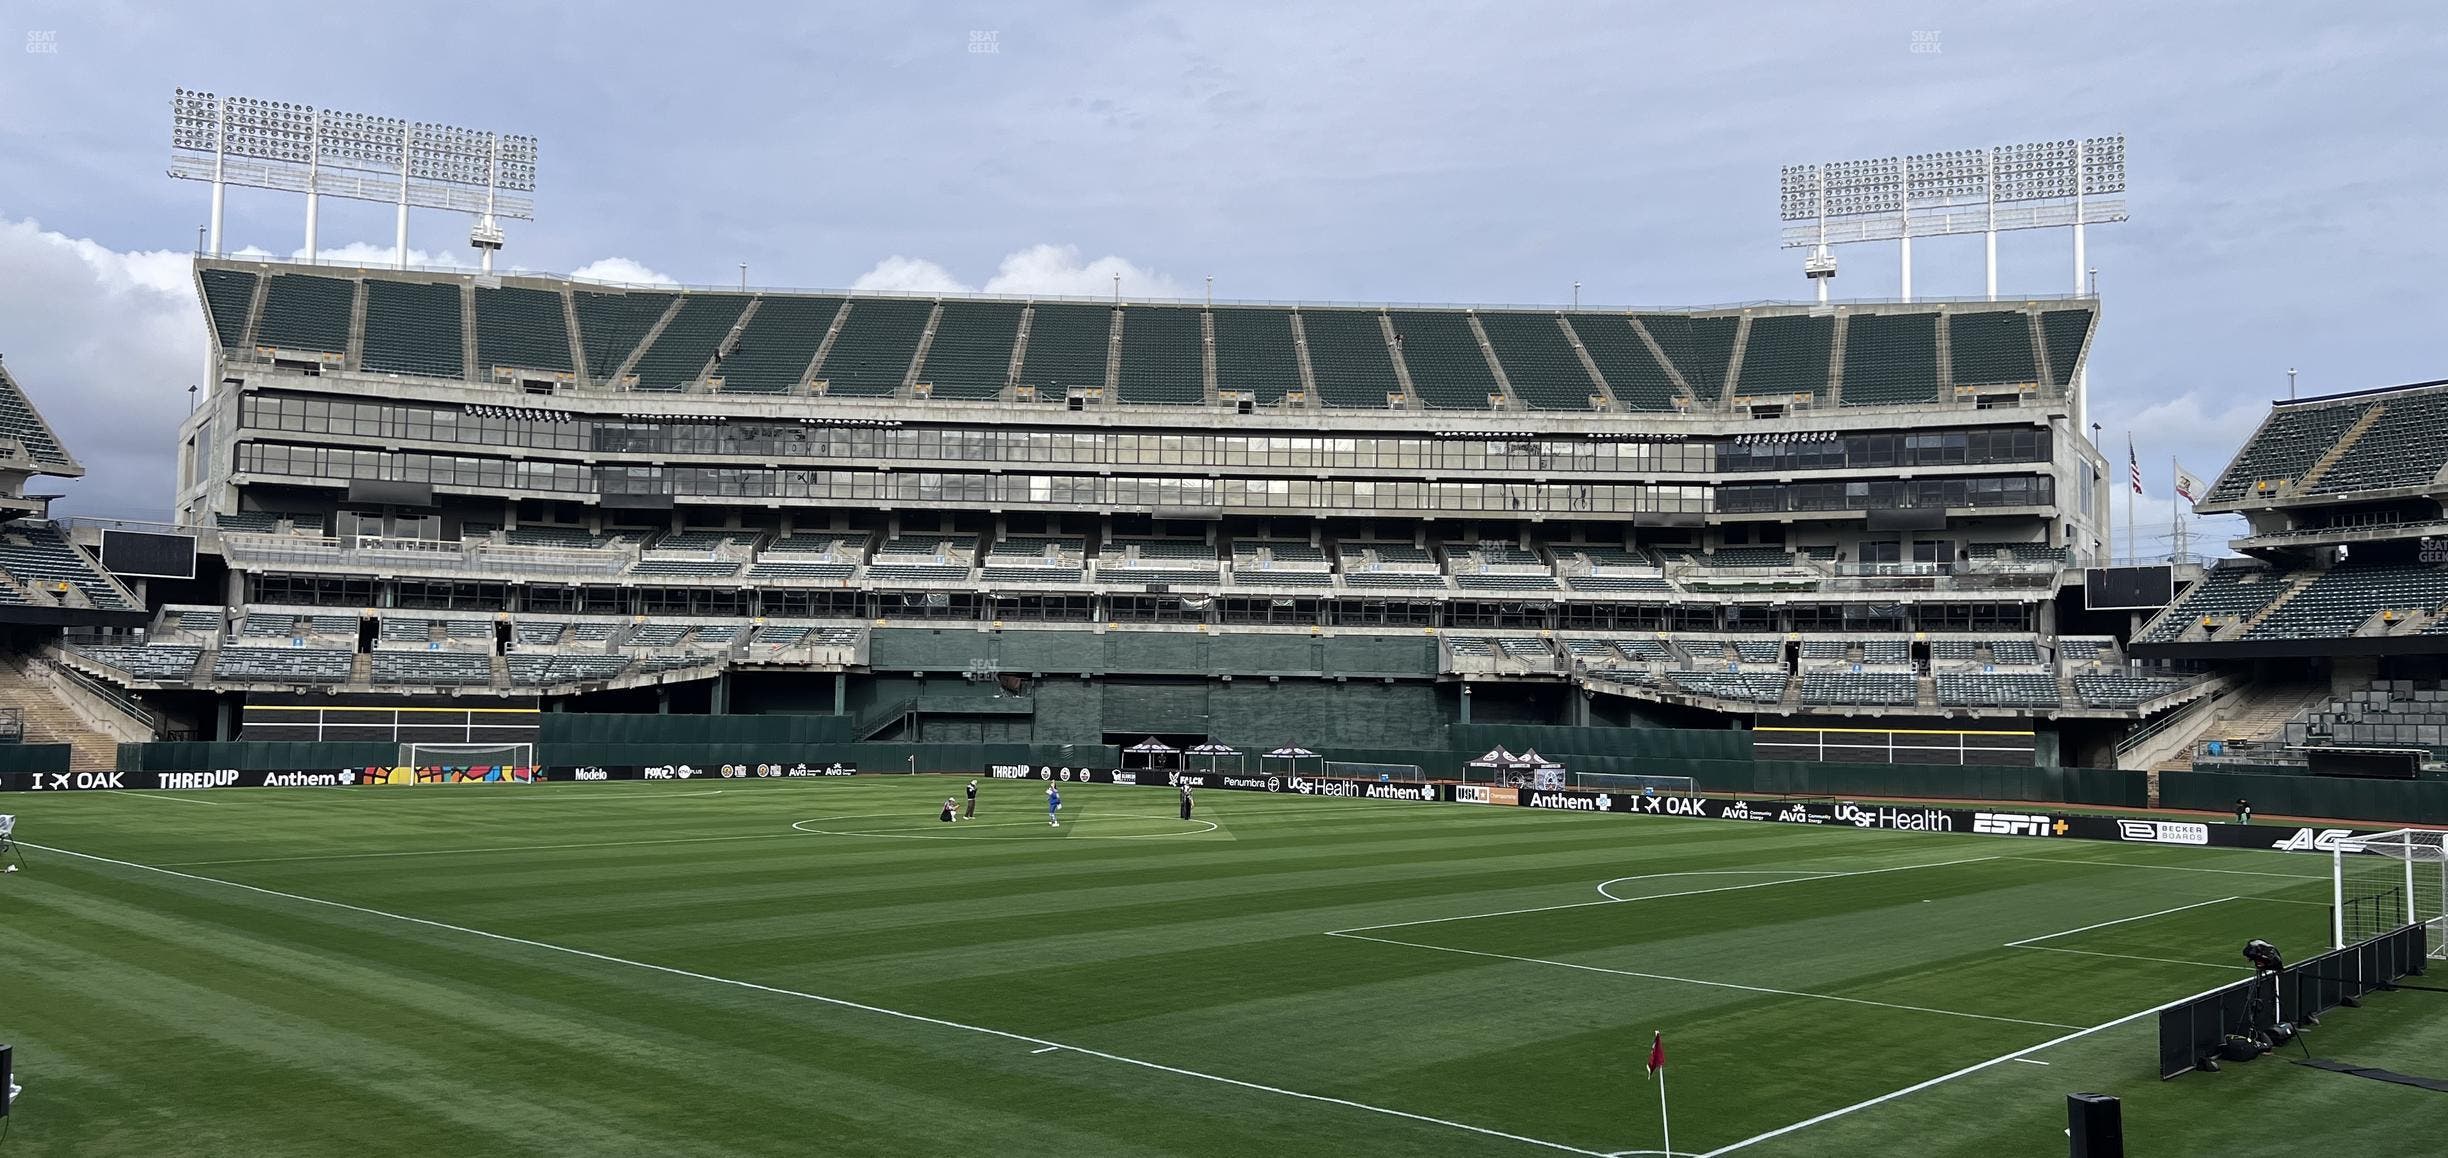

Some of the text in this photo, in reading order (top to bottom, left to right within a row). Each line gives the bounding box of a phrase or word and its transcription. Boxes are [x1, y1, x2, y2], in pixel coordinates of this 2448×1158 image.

[157, 769, 240, 789] THREDUP
[263, 771, 335, 787] Anthem
[575, 767, 608, 780] Modelo
[991, 764, 1030, 779] THREDUP
[76, 771, 125, 789] OAK
[1223, 777, 1266, 788] Penumbra
[1287, 777, 1360, 798] UCSF Health
[1366, 783, 1419, 801] Anthem
[1530, 792, 1594, 811] Anthem
[1666, 797, 1707, 816] OAK
[1721, 806, 1748, 819] Ava
[1778, 810, 1806, 823] Ava
[1834, 805, 1952, 832] UCSF Health
[2161, 825, 2202, 834] BECKER
[2161, 833, 2203, 842] BOARDS
